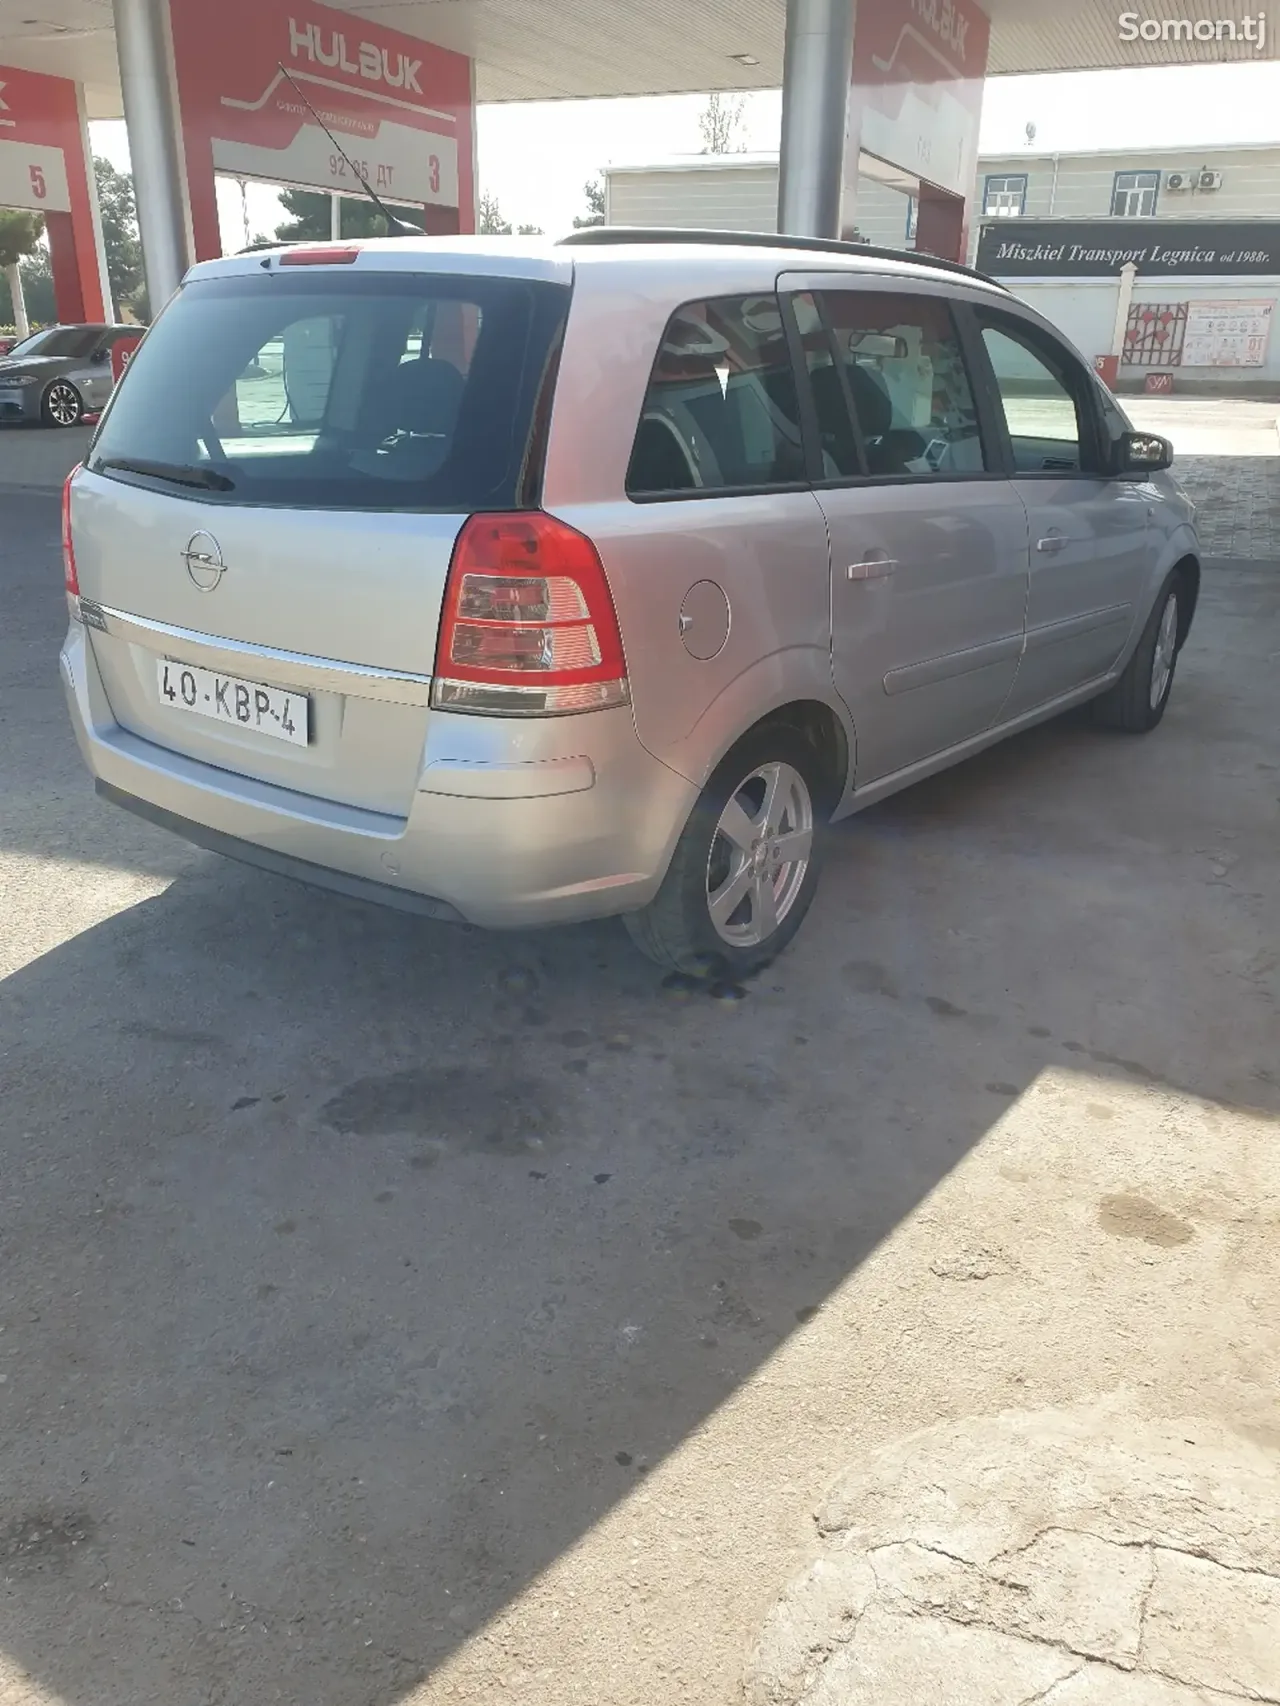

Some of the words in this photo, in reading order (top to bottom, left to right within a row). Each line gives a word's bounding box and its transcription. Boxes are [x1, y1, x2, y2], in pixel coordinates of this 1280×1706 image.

[289, 17, 423, 94] HULBUK
[29, 165, 46, 199] 5
[329, 155, 346, 177] 92
[377, 164, 394, 188] ДТ
[429, 154, 440, 193] 3
[996, 243, 1063, 261] Miszkiel
[1067, 245, 1147, 266] Transport
[1149, 246, 1215, 266] Legnica
[1219, 252, 1234, 264] od
[1237, 251, 1270, 263] 1988r.
